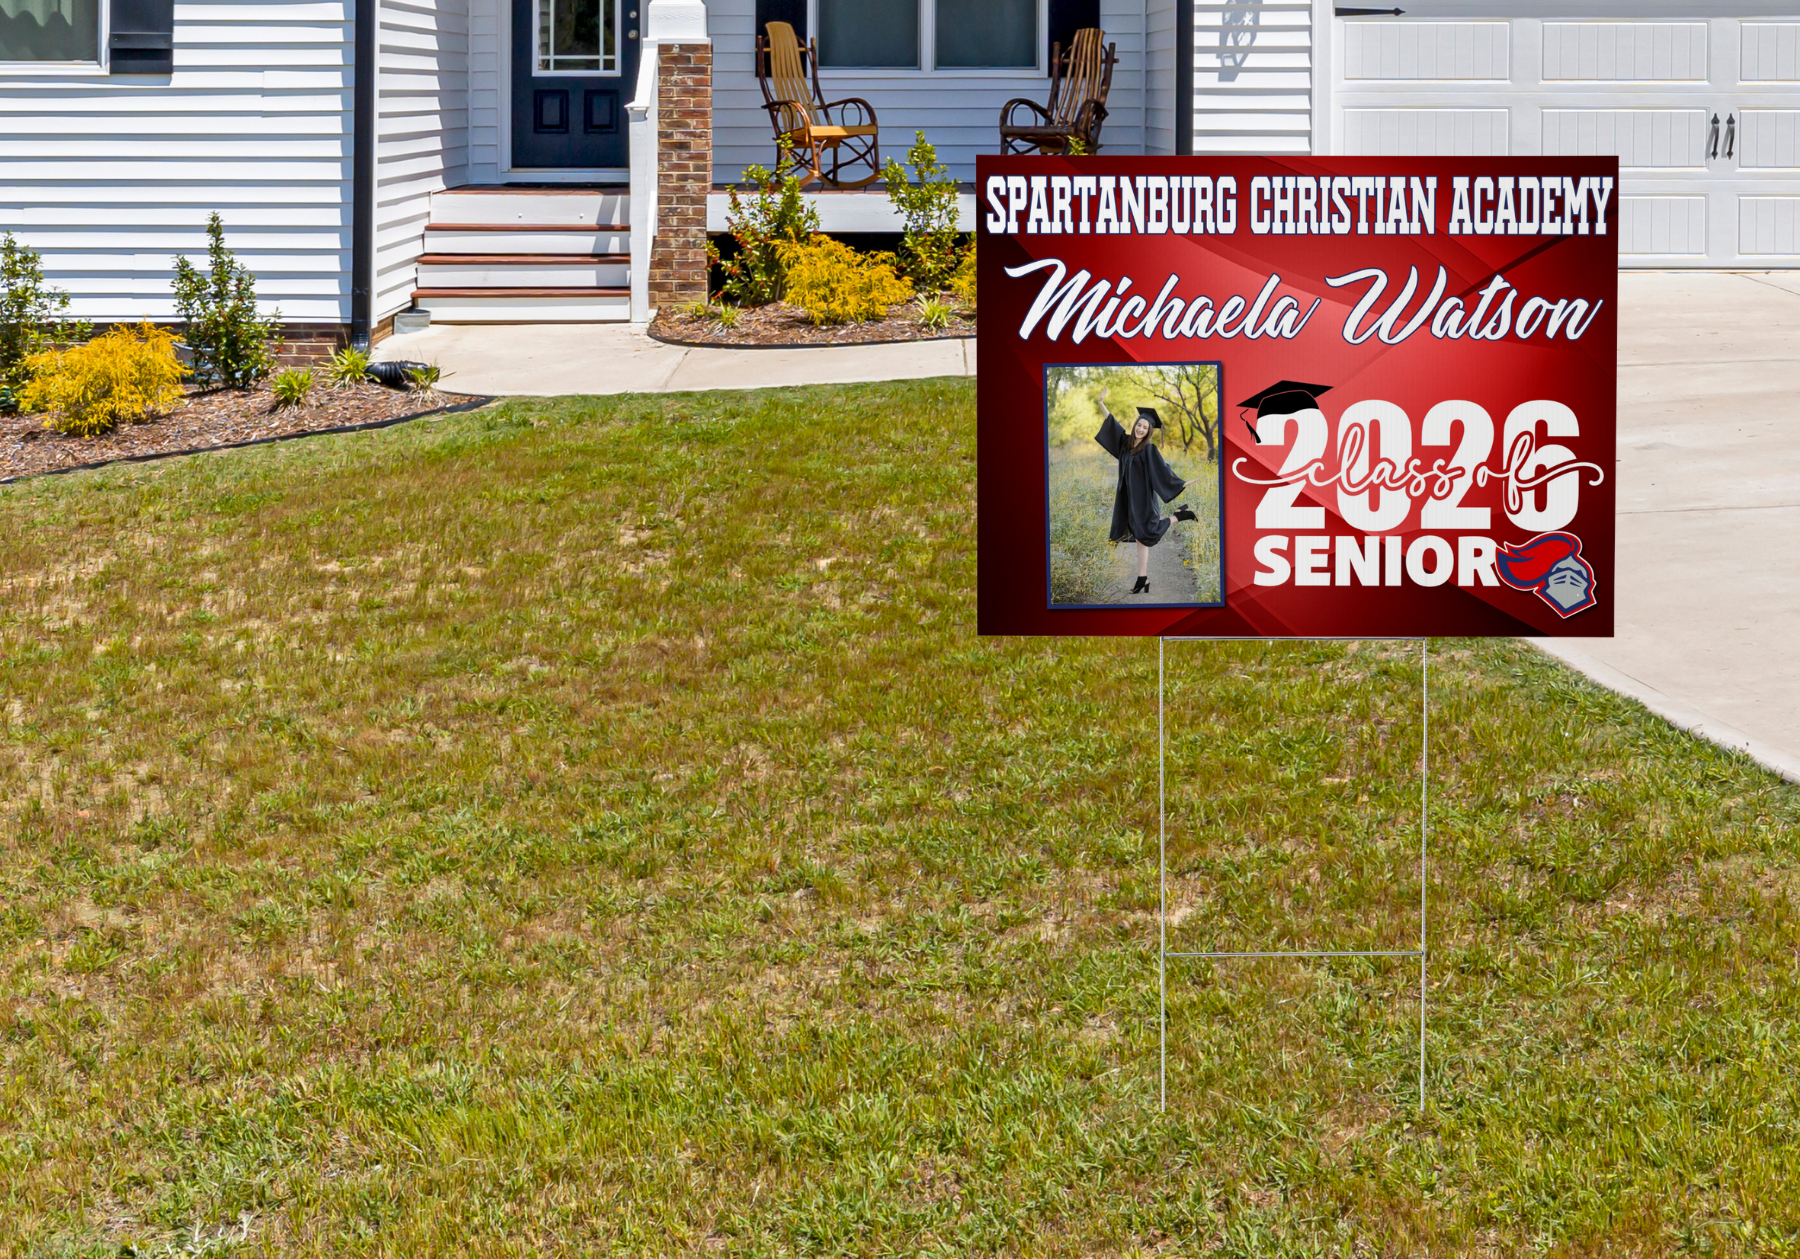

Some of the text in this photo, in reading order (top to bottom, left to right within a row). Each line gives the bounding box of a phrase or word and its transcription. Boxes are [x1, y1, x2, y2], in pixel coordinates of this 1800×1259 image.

[985, 175, 1614, 235] SPARTANBURG CHRISTIAN ACADEMY
[1003, 258, 1603, 346] Michaela Watson
[1232, 423, 1604, 513] class of
[1255, 399, 1580, 532] 2026
[1253, 534, 1501, 588] SENIOR
